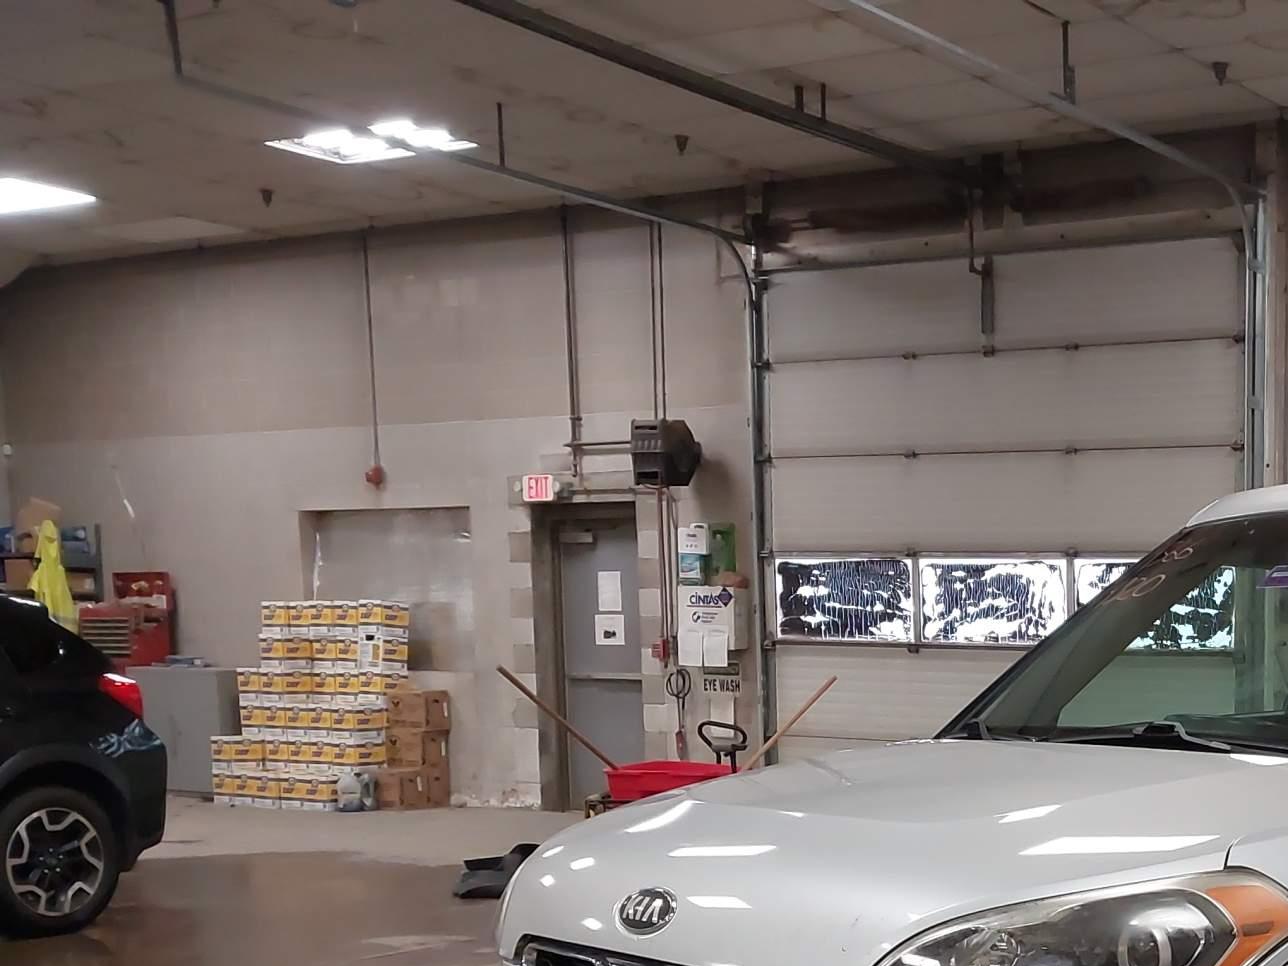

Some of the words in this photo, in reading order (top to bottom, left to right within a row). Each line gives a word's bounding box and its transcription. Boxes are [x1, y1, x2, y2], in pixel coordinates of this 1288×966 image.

[528, 477, 549, 498] EXIT
[703, 679, 718, 692] EYE
[719, 679, 740, 692] WASH
